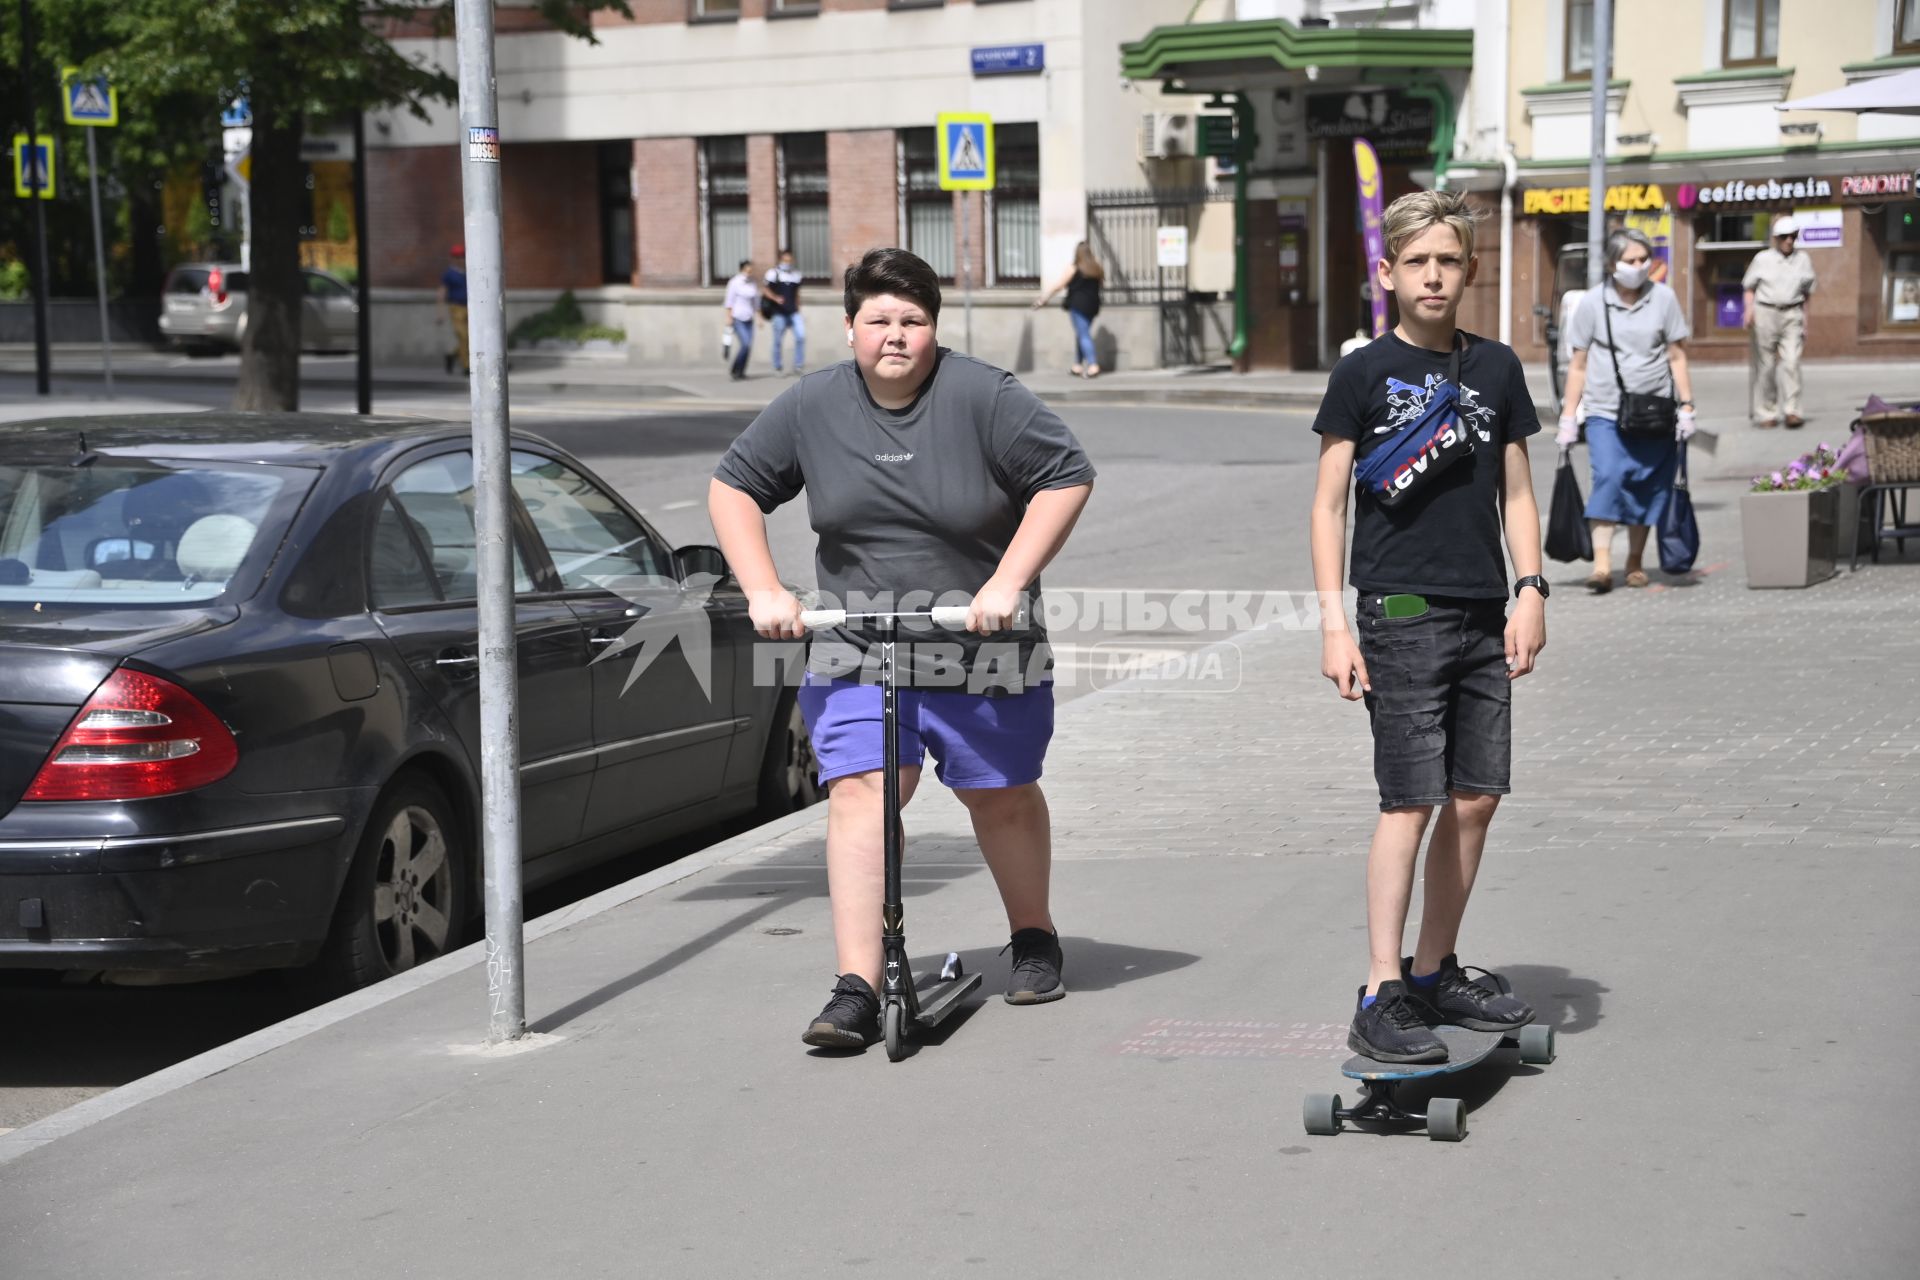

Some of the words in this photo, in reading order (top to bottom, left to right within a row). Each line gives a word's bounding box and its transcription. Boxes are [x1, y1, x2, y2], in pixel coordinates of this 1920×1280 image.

[1026, 47, 1037, 66] 2
[1699, 177, 1831, 204] coffeebrain
[1842, 173, 1912, 195] РЕМОНТ
[1523, 184, 1665, 214] РАСПЕАТКА
[875, 453, 903, 462] adidas
